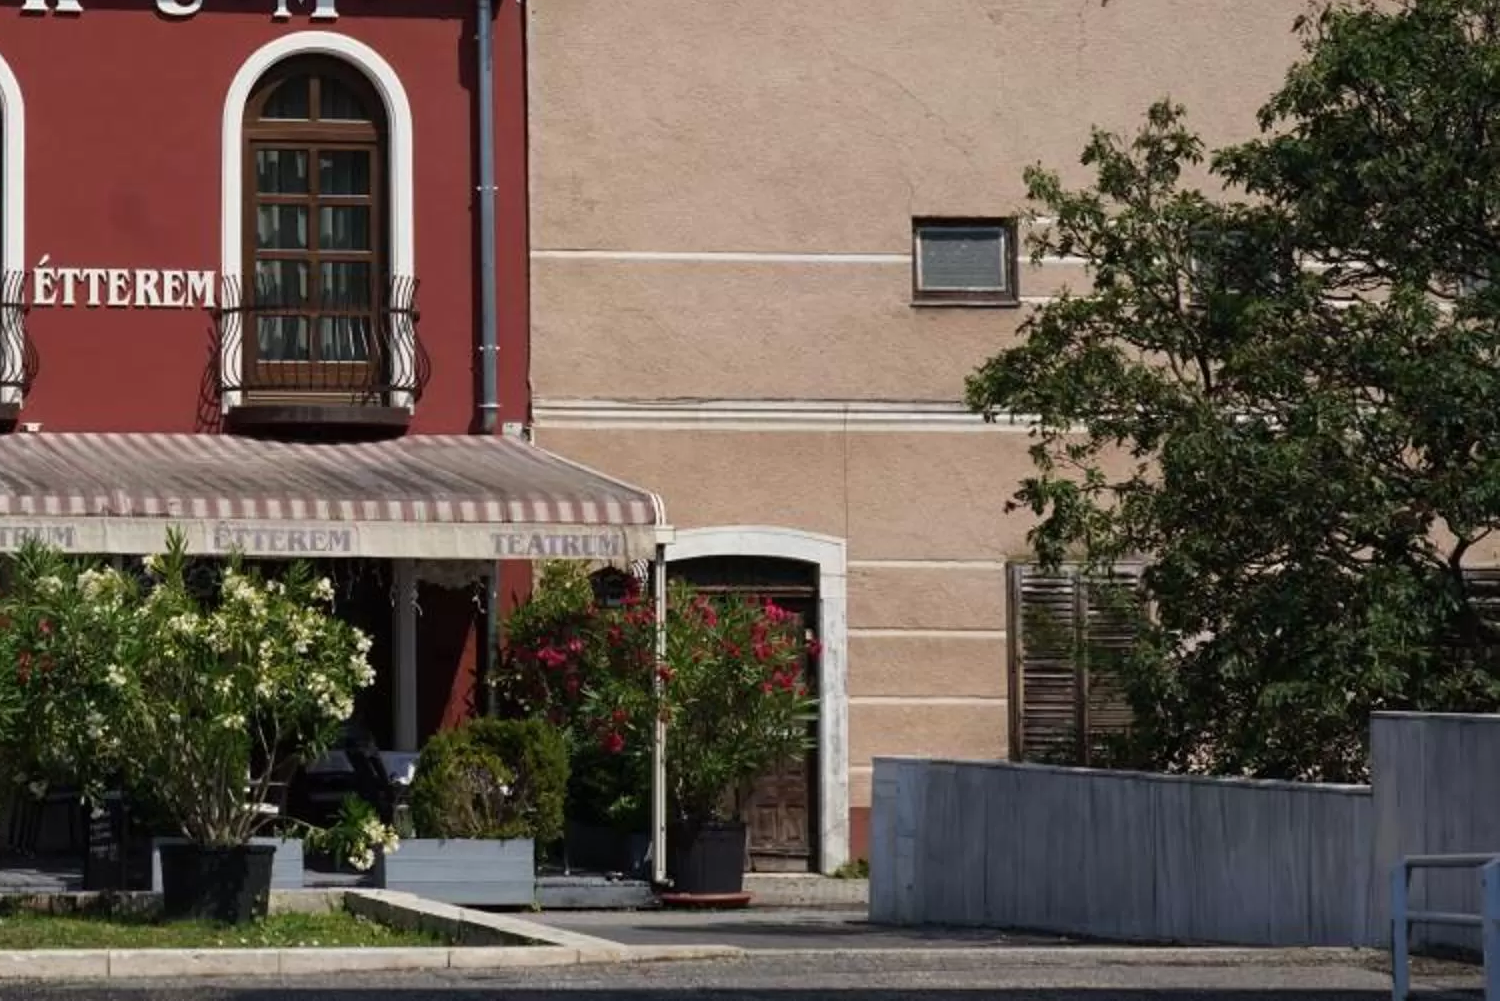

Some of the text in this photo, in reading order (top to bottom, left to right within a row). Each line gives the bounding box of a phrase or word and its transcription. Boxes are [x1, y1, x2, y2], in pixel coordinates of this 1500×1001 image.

[32, 253, 216, 308] ÉTTEREM
[213, 520, 351, 552] ÉTTEREM
[490, 532, 620, 556] TEATRUM
